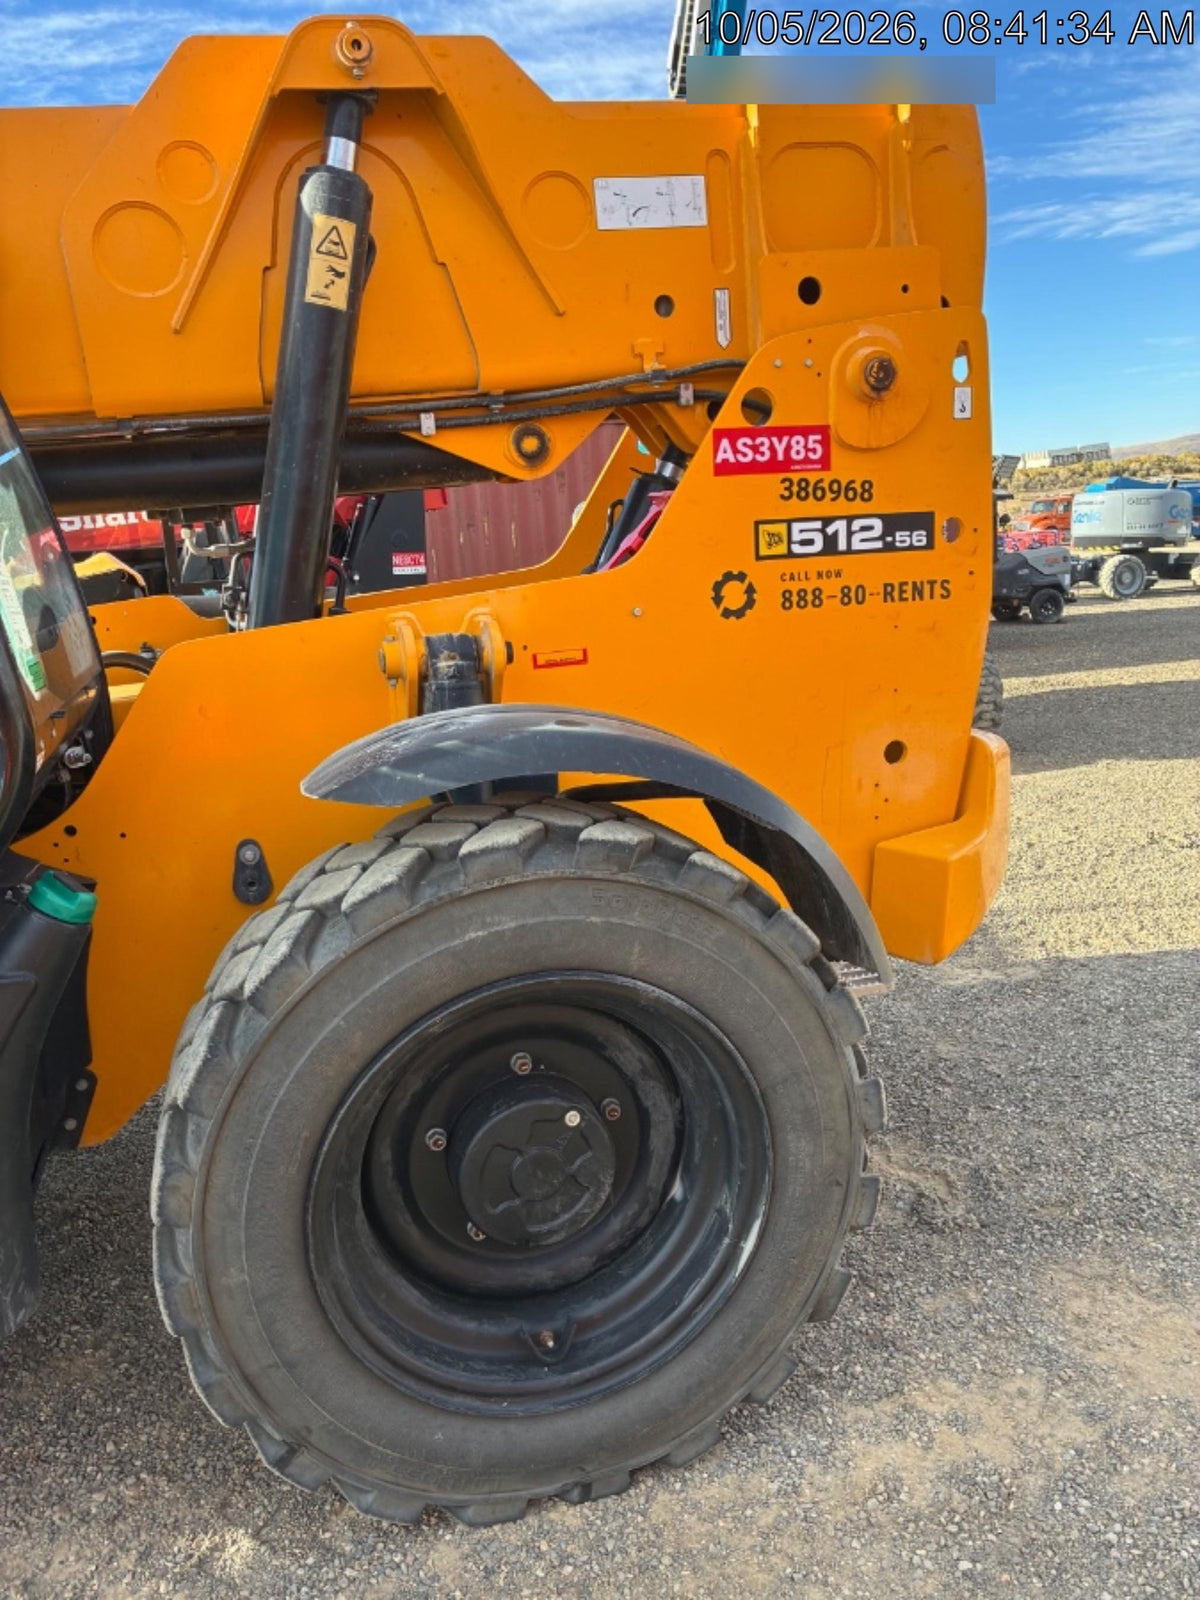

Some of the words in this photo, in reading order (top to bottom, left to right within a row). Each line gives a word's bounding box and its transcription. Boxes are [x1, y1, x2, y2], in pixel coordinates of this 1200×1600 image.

[715, 434, 823, 464] AS3Y85
[779, 477, 875, 502] 386968
[790, 517, 928, 554] 512-56
[780, 570, 811, 582] CALL
[816, 568, 844, 581] NOW
[780, 579, 952, 611] 888-80-RENTS
